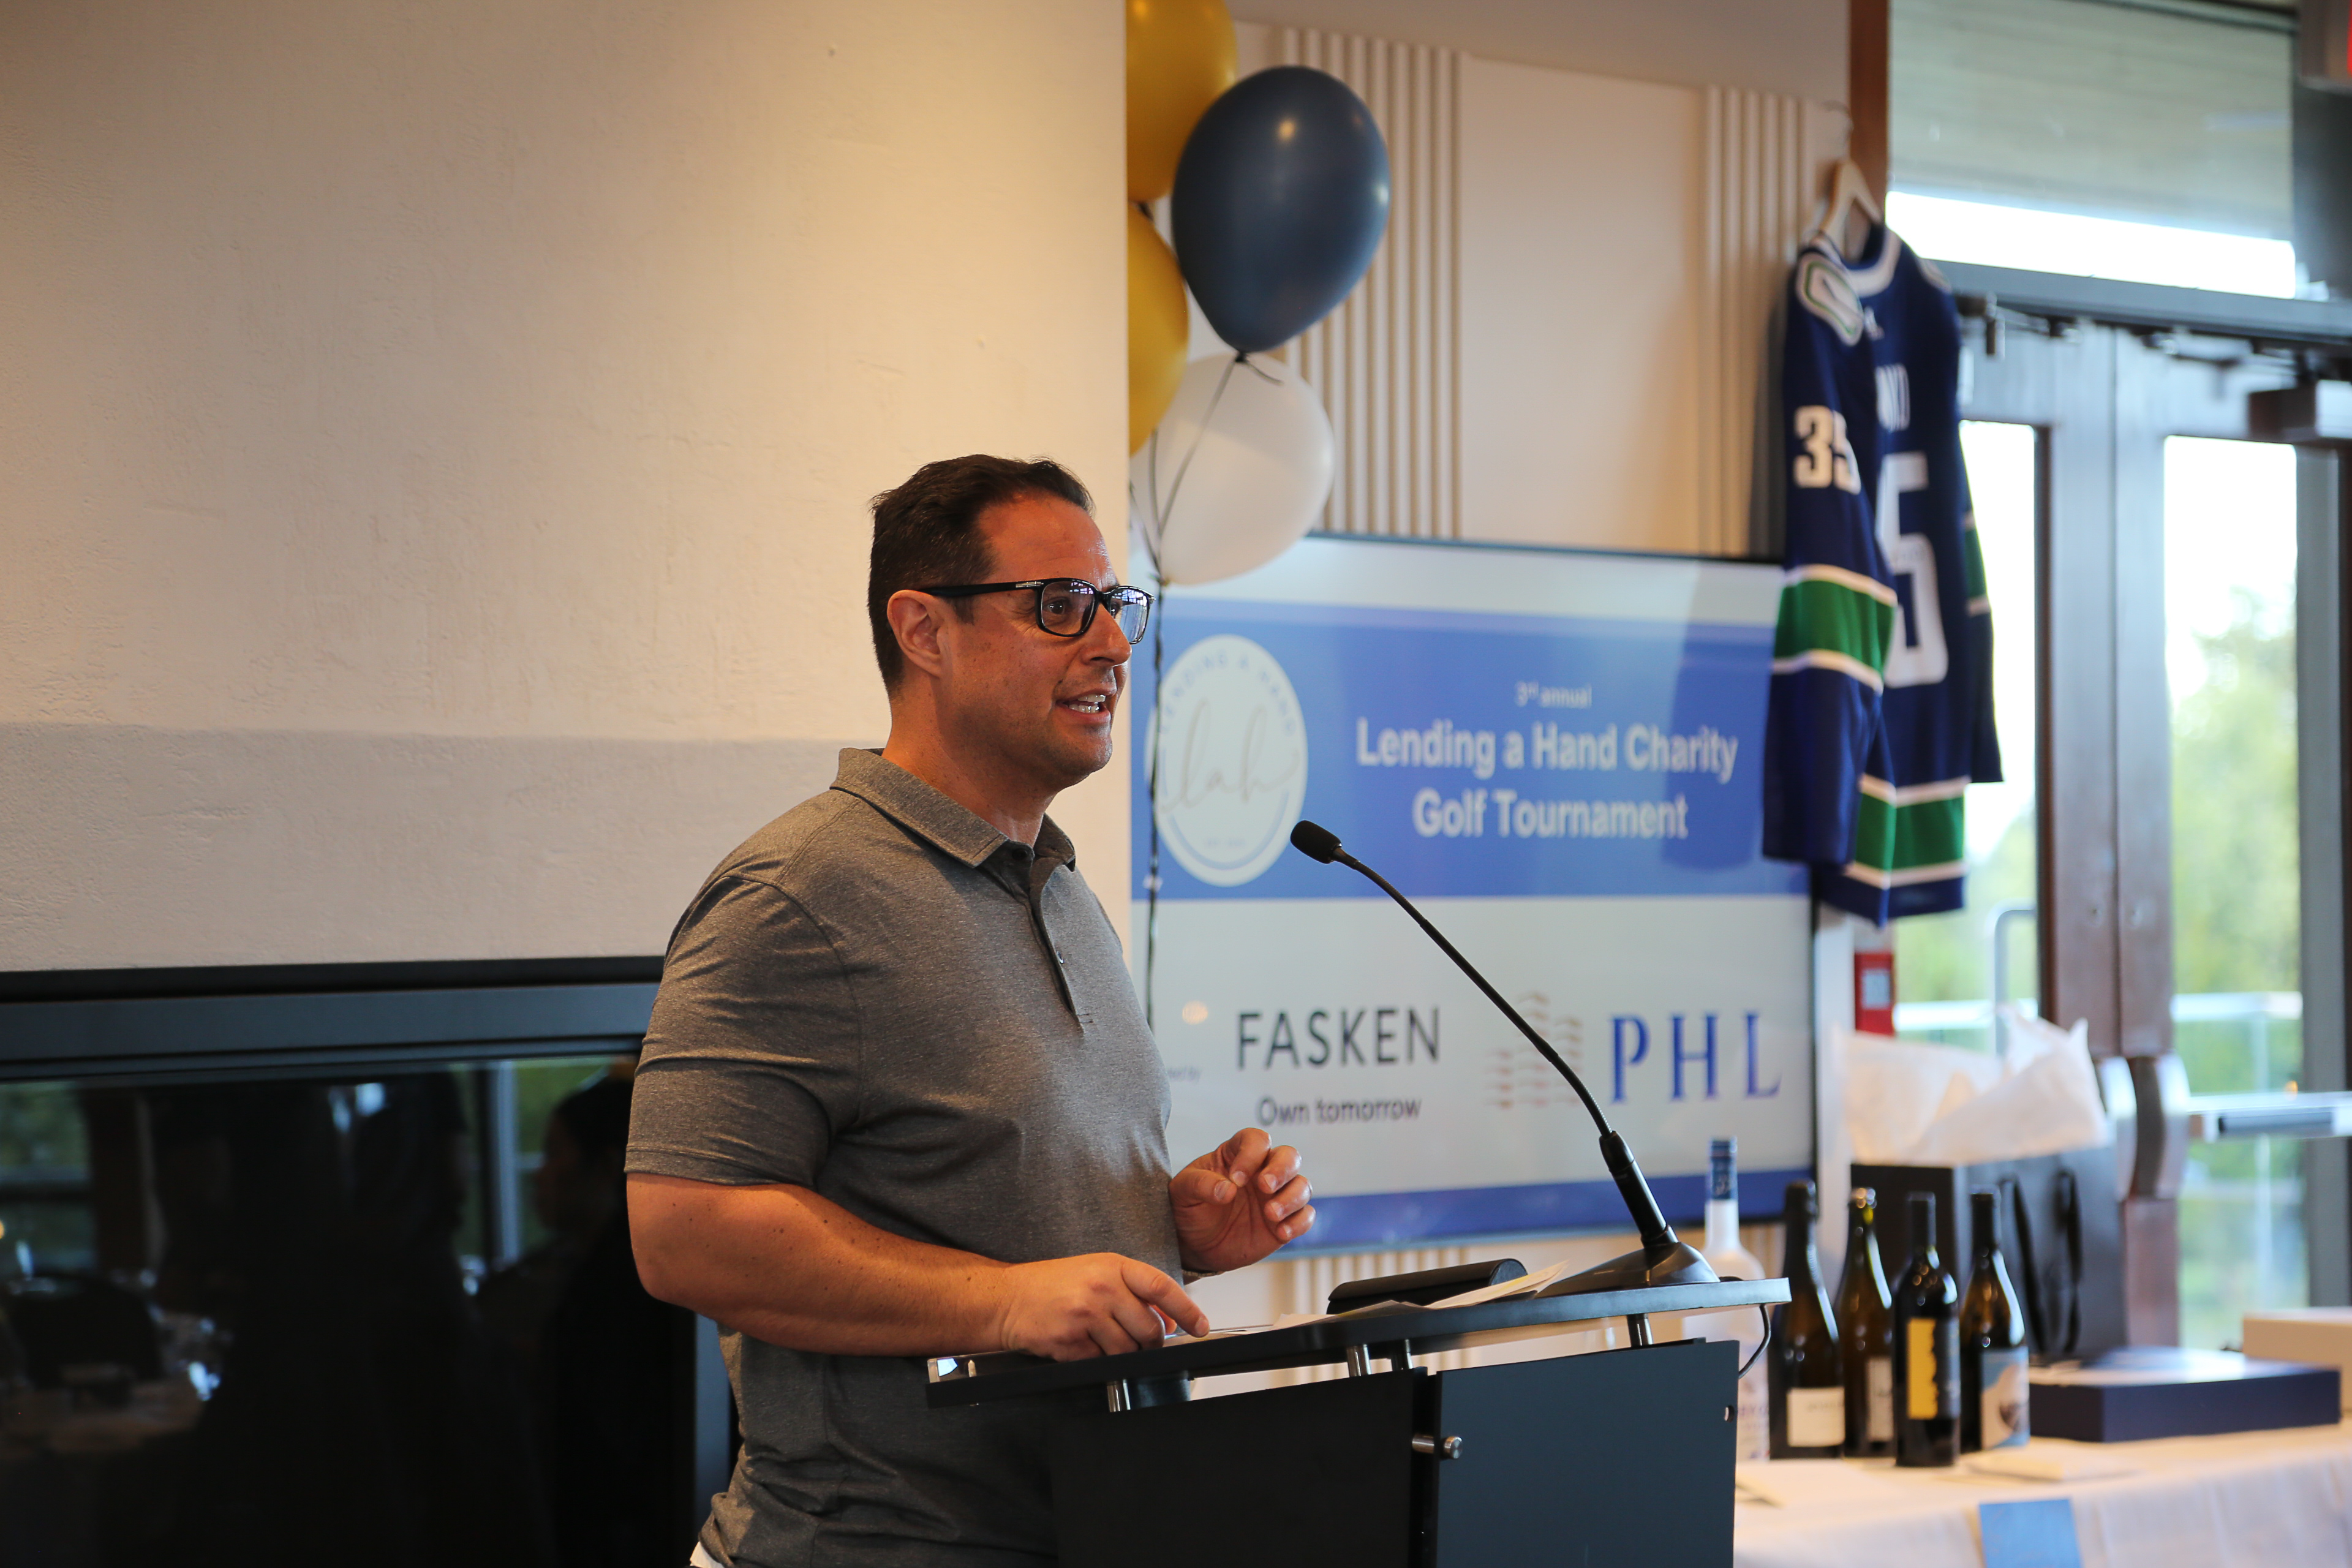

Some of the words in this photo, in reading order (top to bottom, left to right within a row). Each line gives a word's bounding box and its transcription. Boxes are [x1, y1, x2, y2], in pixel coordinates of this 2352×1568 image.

[1540, 684, 1592, 709] annual
[1356, 717, 1496, 780] Lending
[1503, 731, 1525, 769] a
[1532, 720, 1618, 772] Hand
[1625, 723, 1739, 784] Charity
[1411, 786, 1489, 839] Golf
[1491, 787, 1689, 839] Tournament
[1236, 1006, 1441, 1070] FASKEN
[1608, 1009, 1782, 1104] PHL
[1257, 1095, 1310, 1127] Own
[1315, 1097, 1423, 1125] tomorrow
